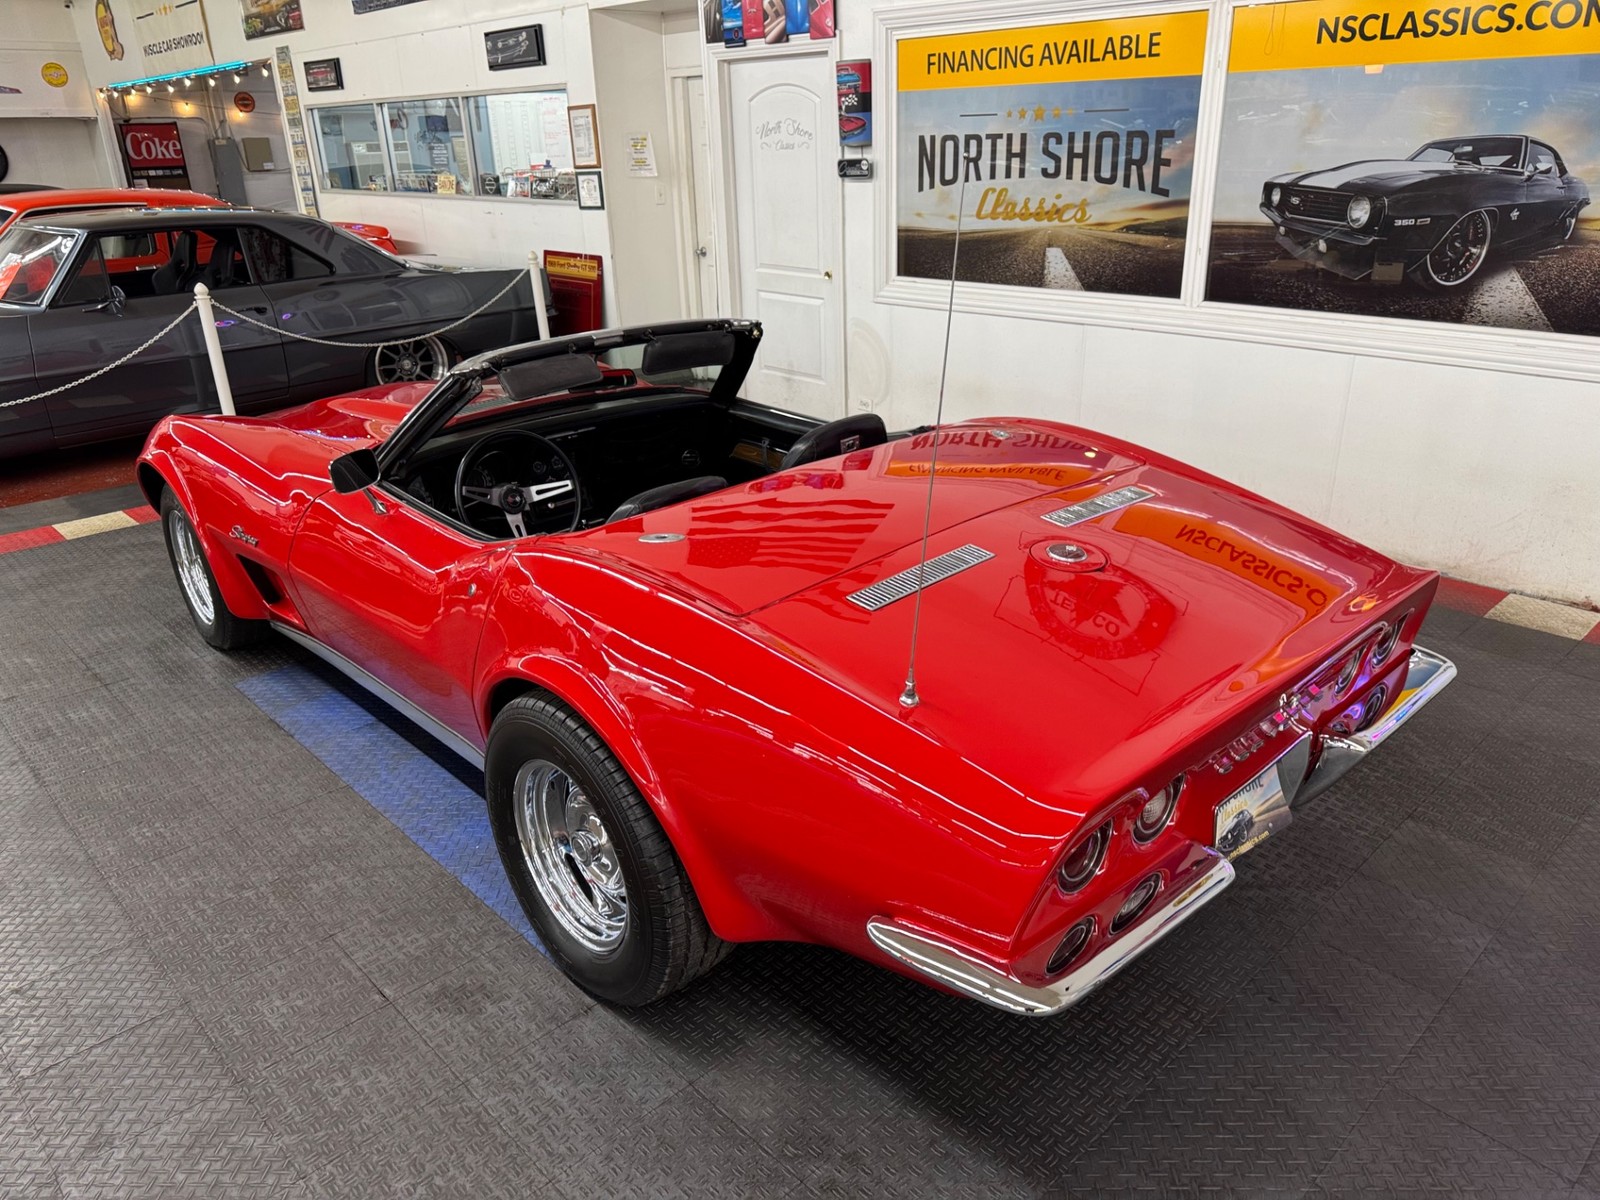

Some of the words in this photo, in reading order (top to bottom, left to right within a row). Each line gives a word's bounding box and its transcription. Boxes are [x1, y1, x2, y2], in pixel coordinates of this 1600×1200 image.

[926, 44, 1034, 75] FINANCING
[1038, 32, 1162, 67] AVAILABLE
[126, 132, 183, 160] Coke
[917, 132, 1028, 193] NORTH
[1040, 129, 1176, 198] SHORE
[975, 186, 1093, 224] Classics
[1393, 217, 1415, 227] 350
